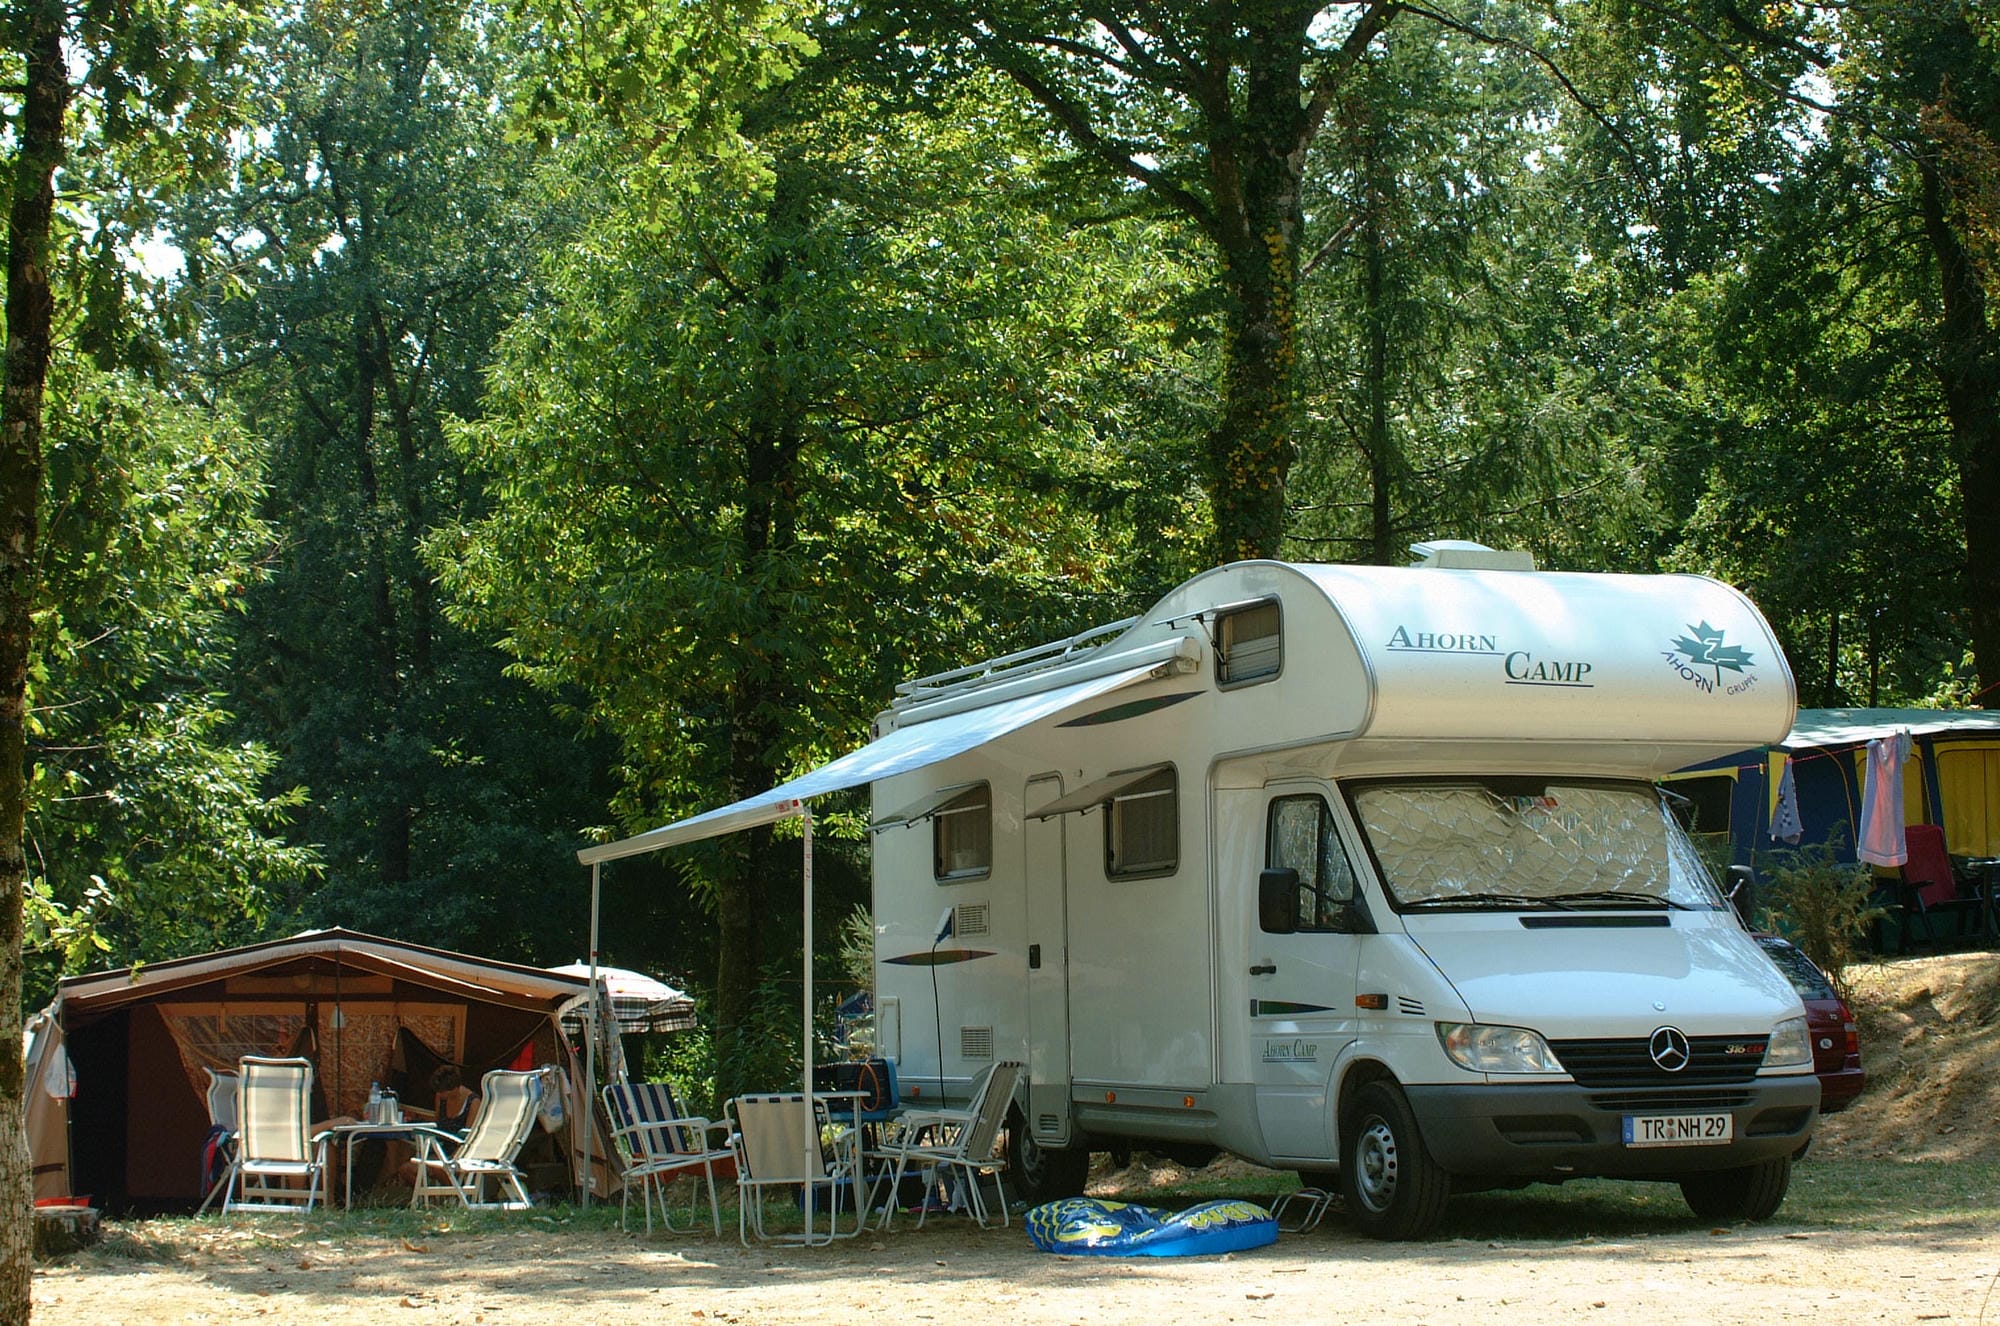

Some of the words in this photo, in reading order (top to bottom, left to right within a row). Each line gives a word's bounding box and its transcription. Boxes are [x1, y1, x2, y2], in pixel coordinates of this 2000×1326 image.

[1385, 625, 1496, 651] AHORN
[1504, 650, 1592, 682] CAMP
[1660, 651, 1714, 694] AHORN
[1641, 1119, 1666, 1139] TR
[1677, 1118, 1701, 1138] NH
[1705, 1116, 1726, 1137] 29
